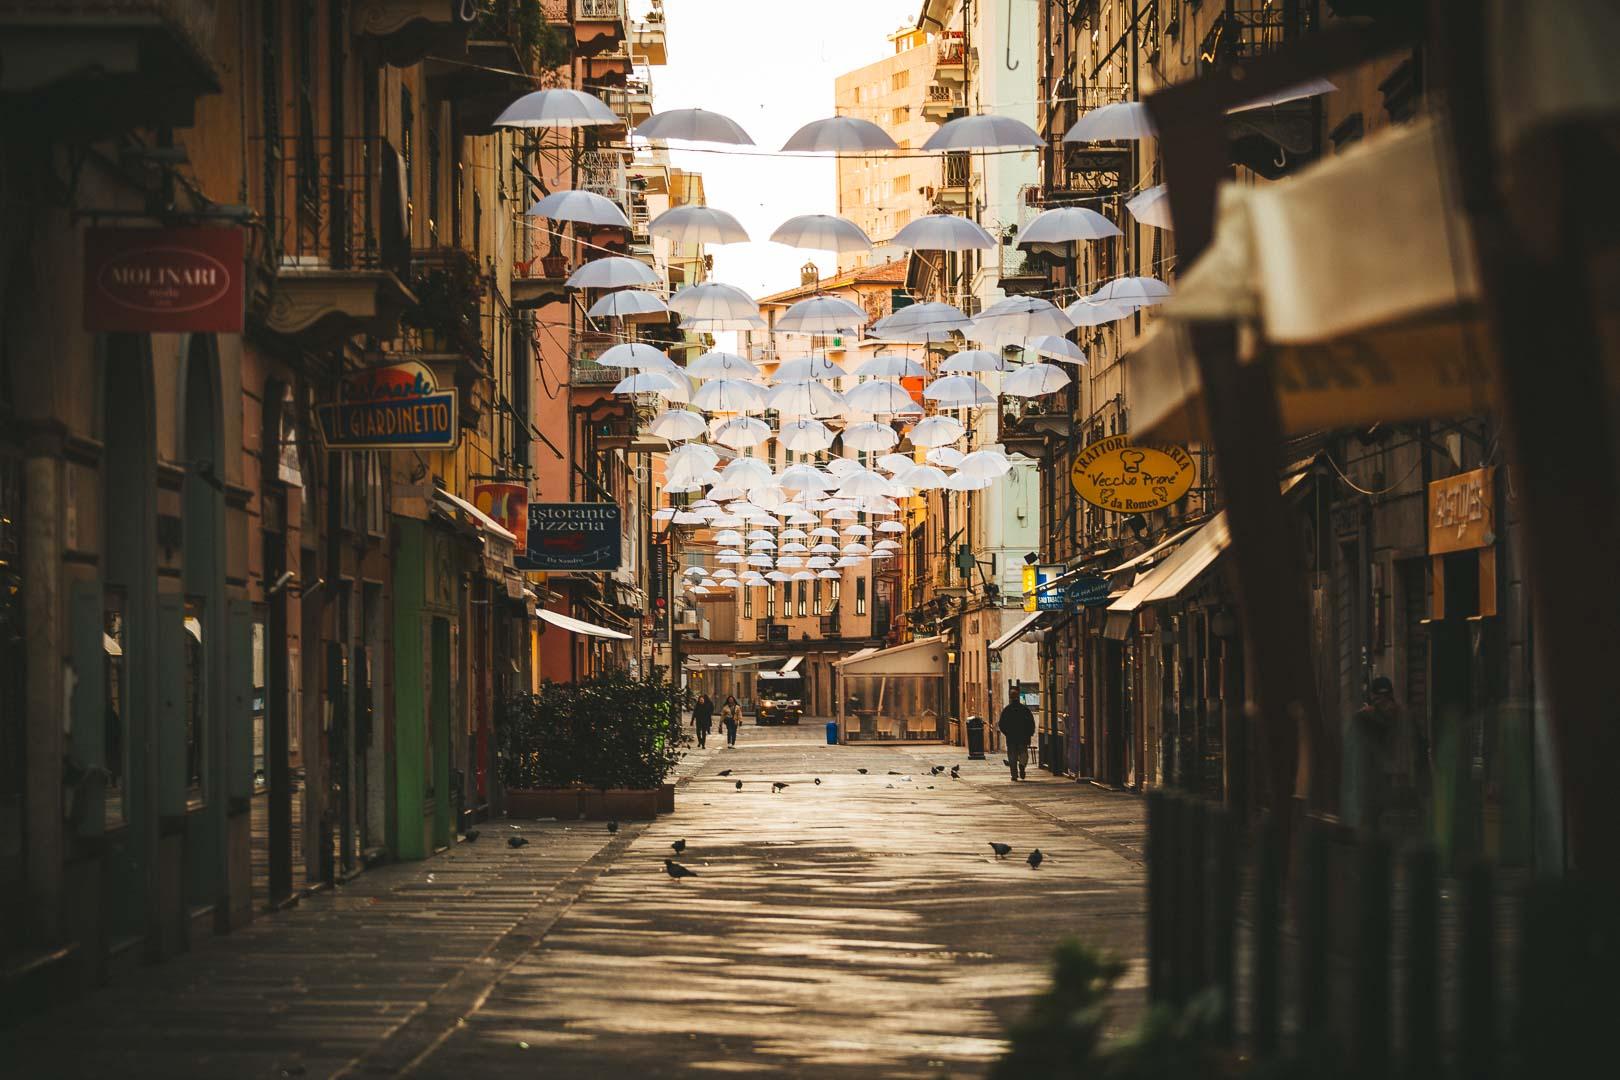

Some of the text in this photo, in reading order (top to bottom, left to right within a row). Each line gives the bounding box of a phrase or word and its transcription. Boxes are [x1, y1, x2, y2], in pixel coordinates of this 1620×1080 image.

[112, 267, 217, 285] MOLINARI
[351, 403, 448, 437] GIARDINETTO
[1073, 436, 1129, 475] TRATTORI
[1111, 498, 1158, 510] da Romeo
[531, 506, 617, 519] istorante
[528, 517, 605, 531] Pizzeria
